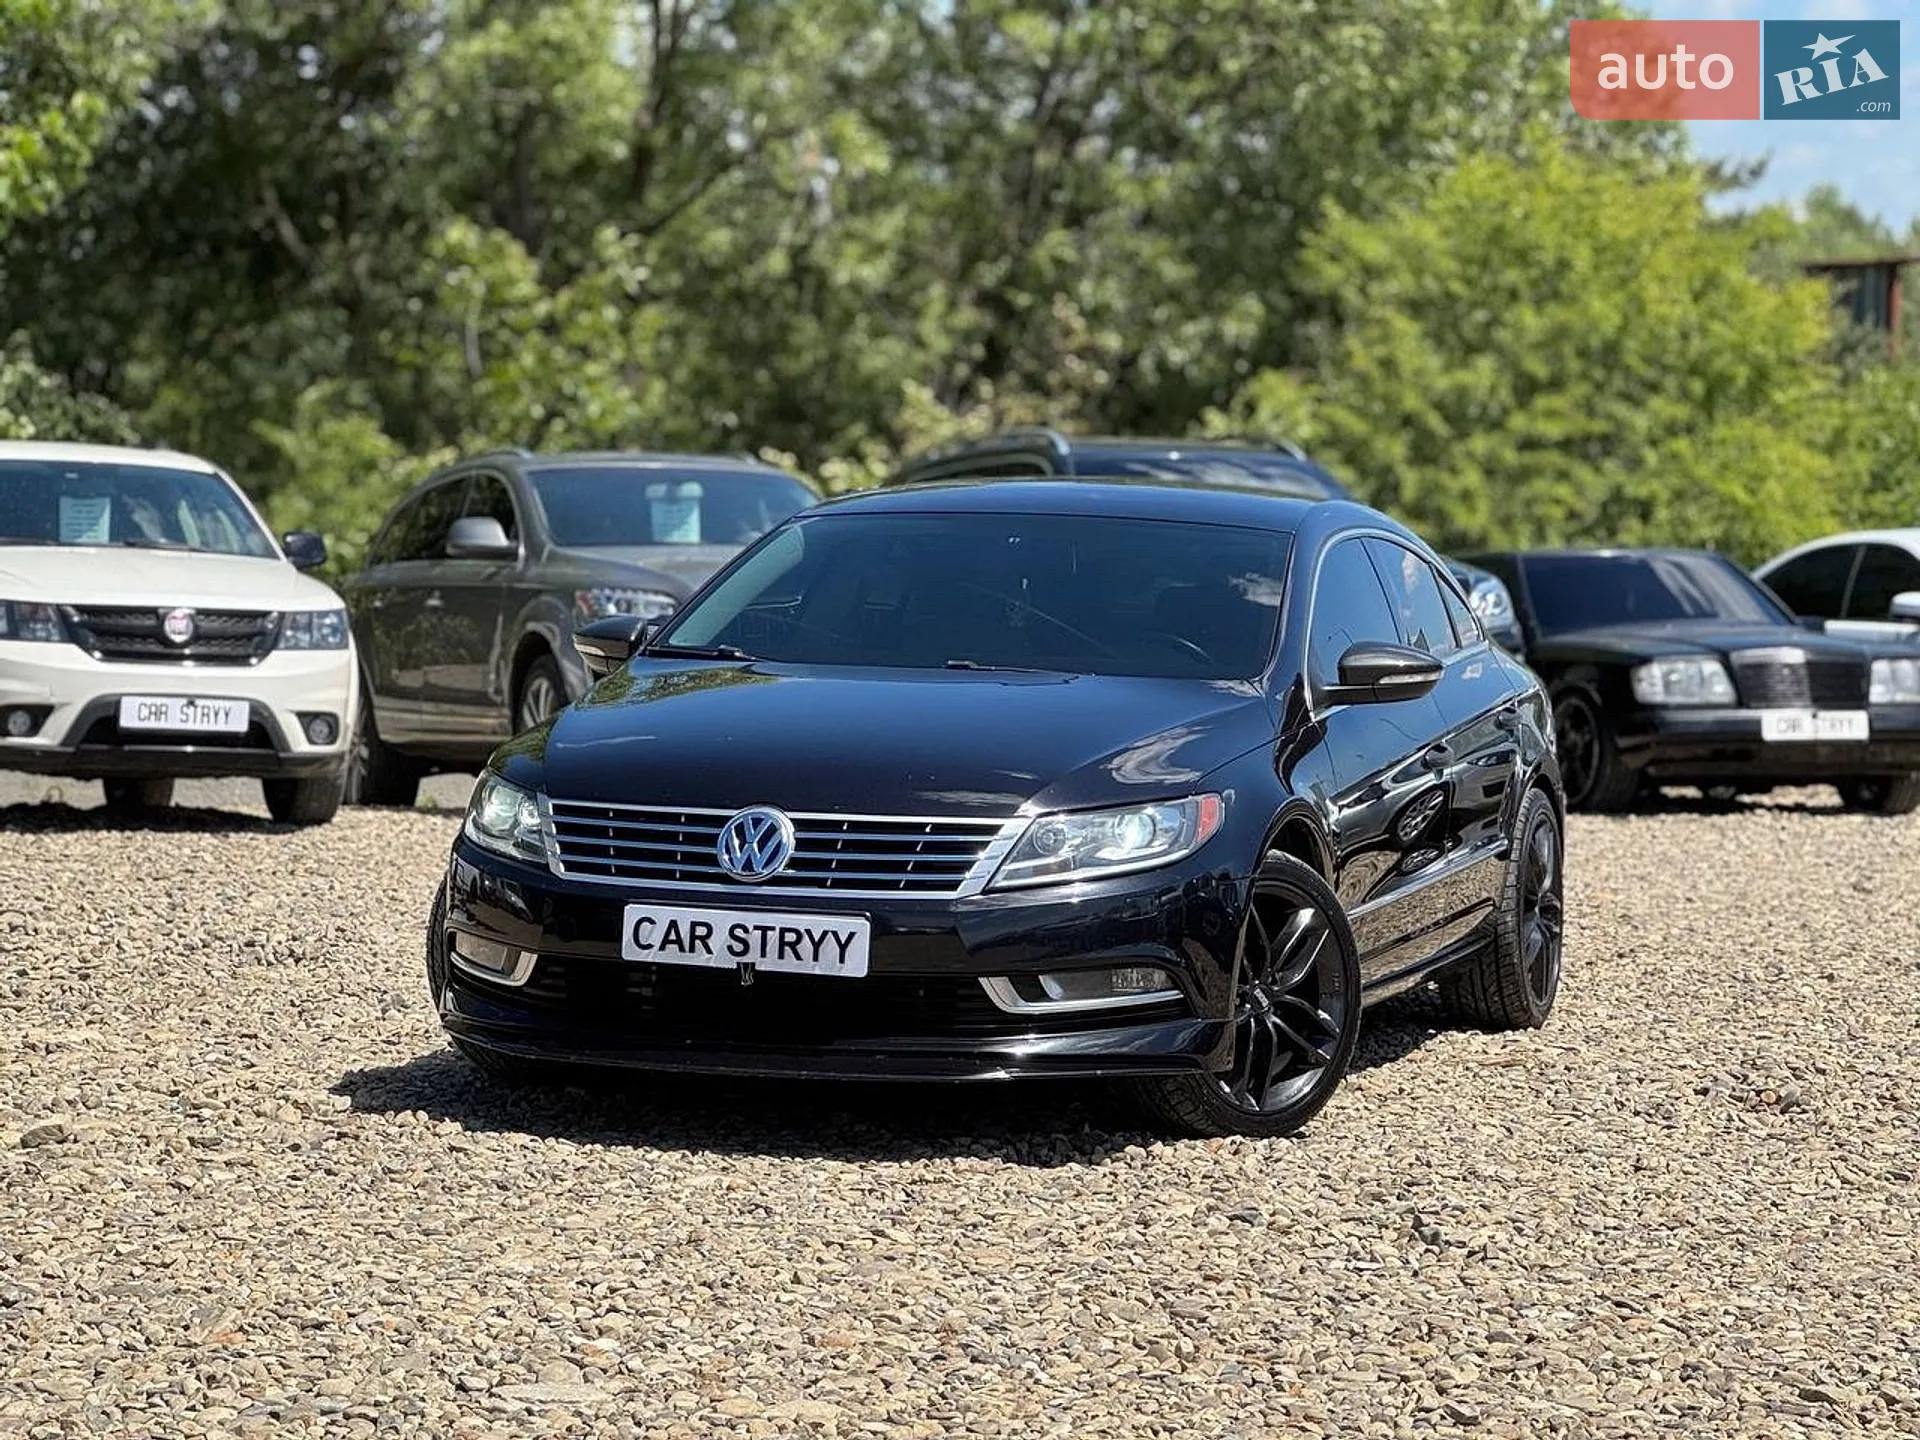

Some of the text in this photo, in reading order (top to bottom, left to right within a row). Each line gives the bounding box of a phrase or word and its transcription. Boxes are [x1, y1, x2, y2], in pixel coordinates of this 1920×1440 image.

[137, 702, 232, 726] CAR STRYY
[632, 916, 858, 965] CAR STRYY
